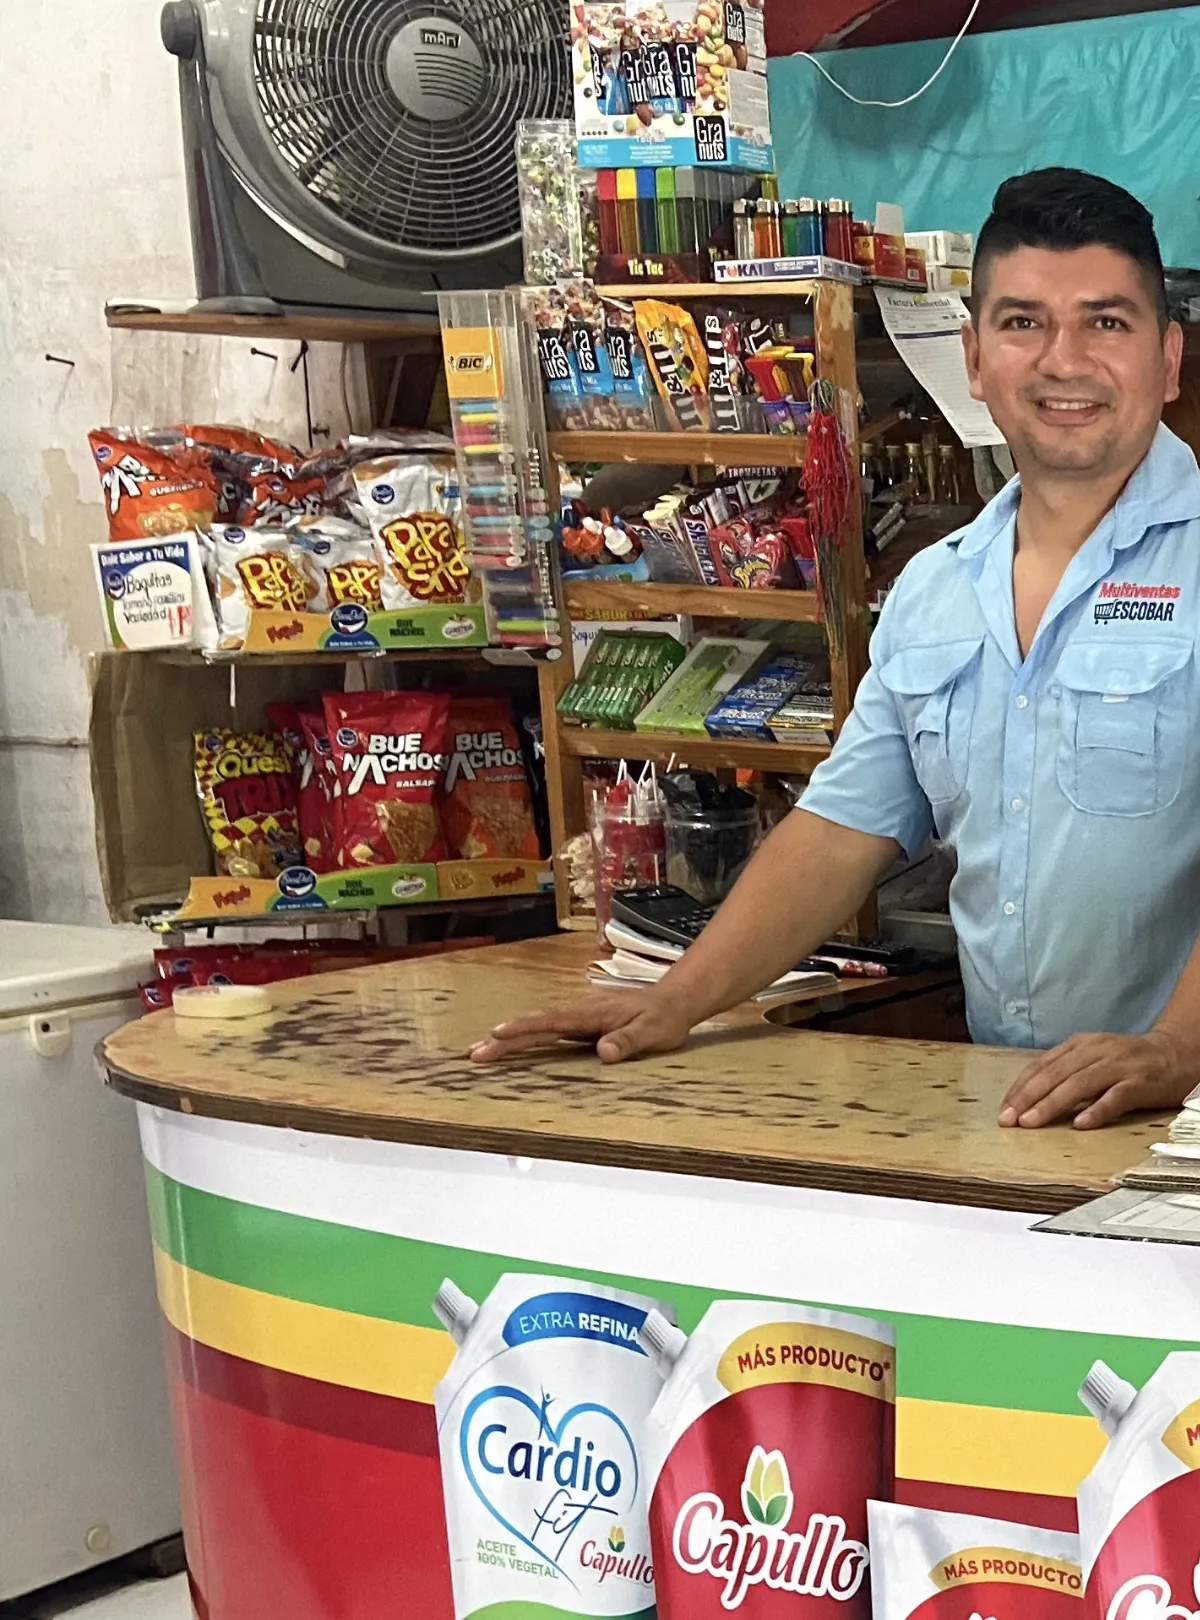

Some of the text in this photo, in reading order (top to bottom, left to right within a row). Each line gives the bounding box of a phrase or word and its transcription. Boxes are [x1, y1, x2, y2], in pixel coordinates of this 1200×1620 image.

[696, 116, 723, 144] Gra
[699, 142, 725, 162] nuts
[458, 358, 483, 369] BIC
[1099, 582, 1182, 600] Multiventas
[1113, 600, 1175, 621] ESCOBAR
[368, 732, 423, 754] BUE
[456, 732, 504, 750] BUE
[342, 751, 444, 796] NACHOS
[519, 1315, 574, 1335] EXTRA
[737, 1344, 775, 1374] MÁS
[478, 1423, 622, 1498] Cardio
[531, 1488, 619, 1563] fit
[476, 1538, 516, 1556] ACEITE
[675, 1496, 867, 1603] Capullo
[476, 1551, 559, 1580] 100% VEGETAL
[579, 1538, 655, 1584] Capullo
[944, 1558, 978, 1581] MÁS
